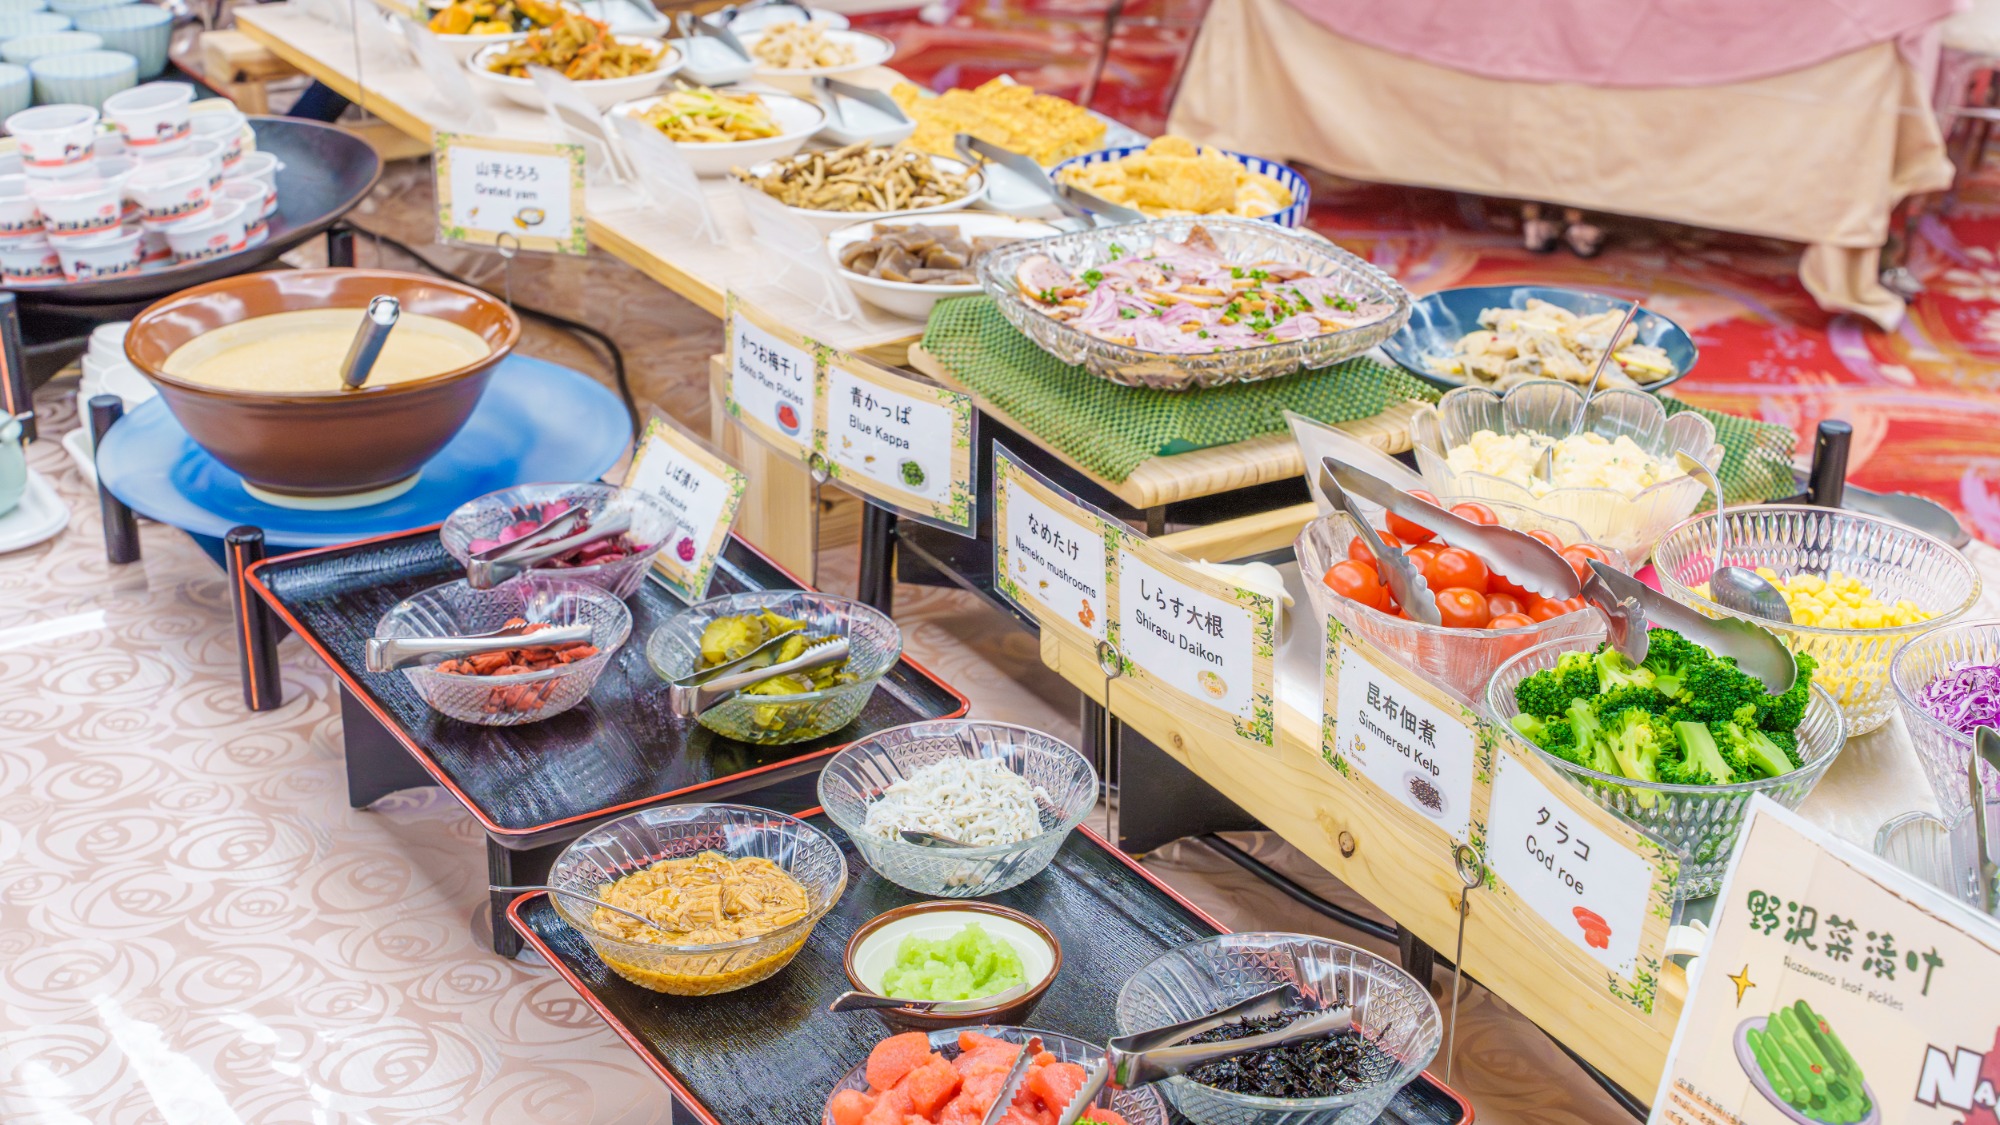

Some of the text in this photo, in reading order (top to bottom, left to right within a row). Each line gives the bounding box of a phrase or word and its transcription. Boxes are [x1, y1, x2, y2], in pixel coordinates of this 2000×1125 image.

[475, 160, 540, 181] 山芋とろろ
[515, 189, 539, 201] yam
[741, 332, 802, 382] かつお梅干し
[758, 371, 775, 391] Plum
[777, 382, 804, 406] Pickles
[849, 386, 912, 425] 青かっぱ
[849, 414, 911, 450] Blue Kappa
[665, 460, 700, 494] しば漬け
[1028, 512, 1080, 561] なめたけ
[1015, 534, 1097, 599] Nameko mushrooms
[1140, 578, 1225, 640] しらす大根
[1135, 608, 1224, 667] Shirasu Daikon
[1366, 680, 1438, 750] 昆布佃煮
[1358, 709, 1411, 760] Simmered
[1413, 752, 1441, 777] Kelp
[1536, 805, 1592, 862] タラコ
[1525, 834, 1585, 897] Cod roe
[1841, 976, 1864, 997] leaf
[1867, 990, 1904, 1012] pickles
